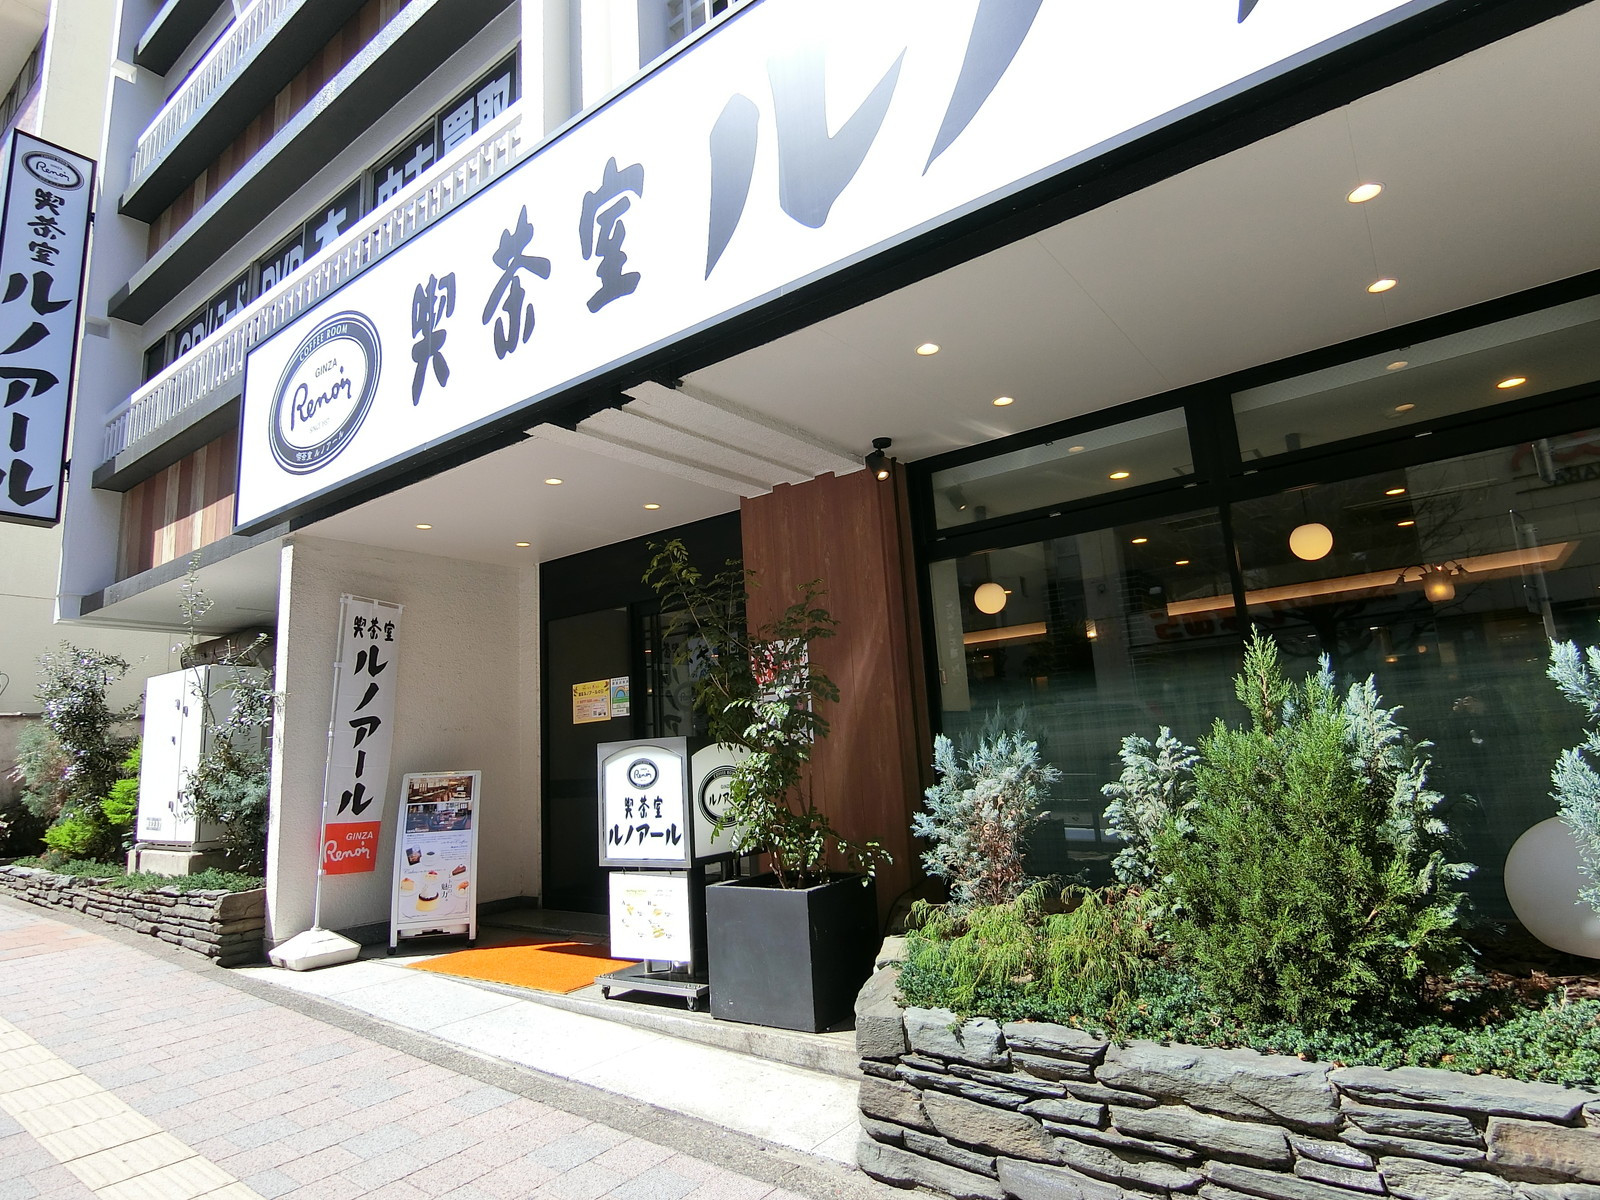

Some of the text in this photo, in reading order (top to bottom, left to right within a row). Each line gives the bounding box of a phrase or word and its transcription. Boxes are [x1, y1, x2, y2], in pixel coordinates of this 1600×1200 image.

[300, 324, 348, 361] COFFEE ROOM
[315, 358, 338, 378] GINZA
[336, 644, 388, 816] ルノアール
[346, 831, 373, 840] GINZA
[609, 823, 682, 846] ルノアール
[324, 841, 370, 863] Renoir
